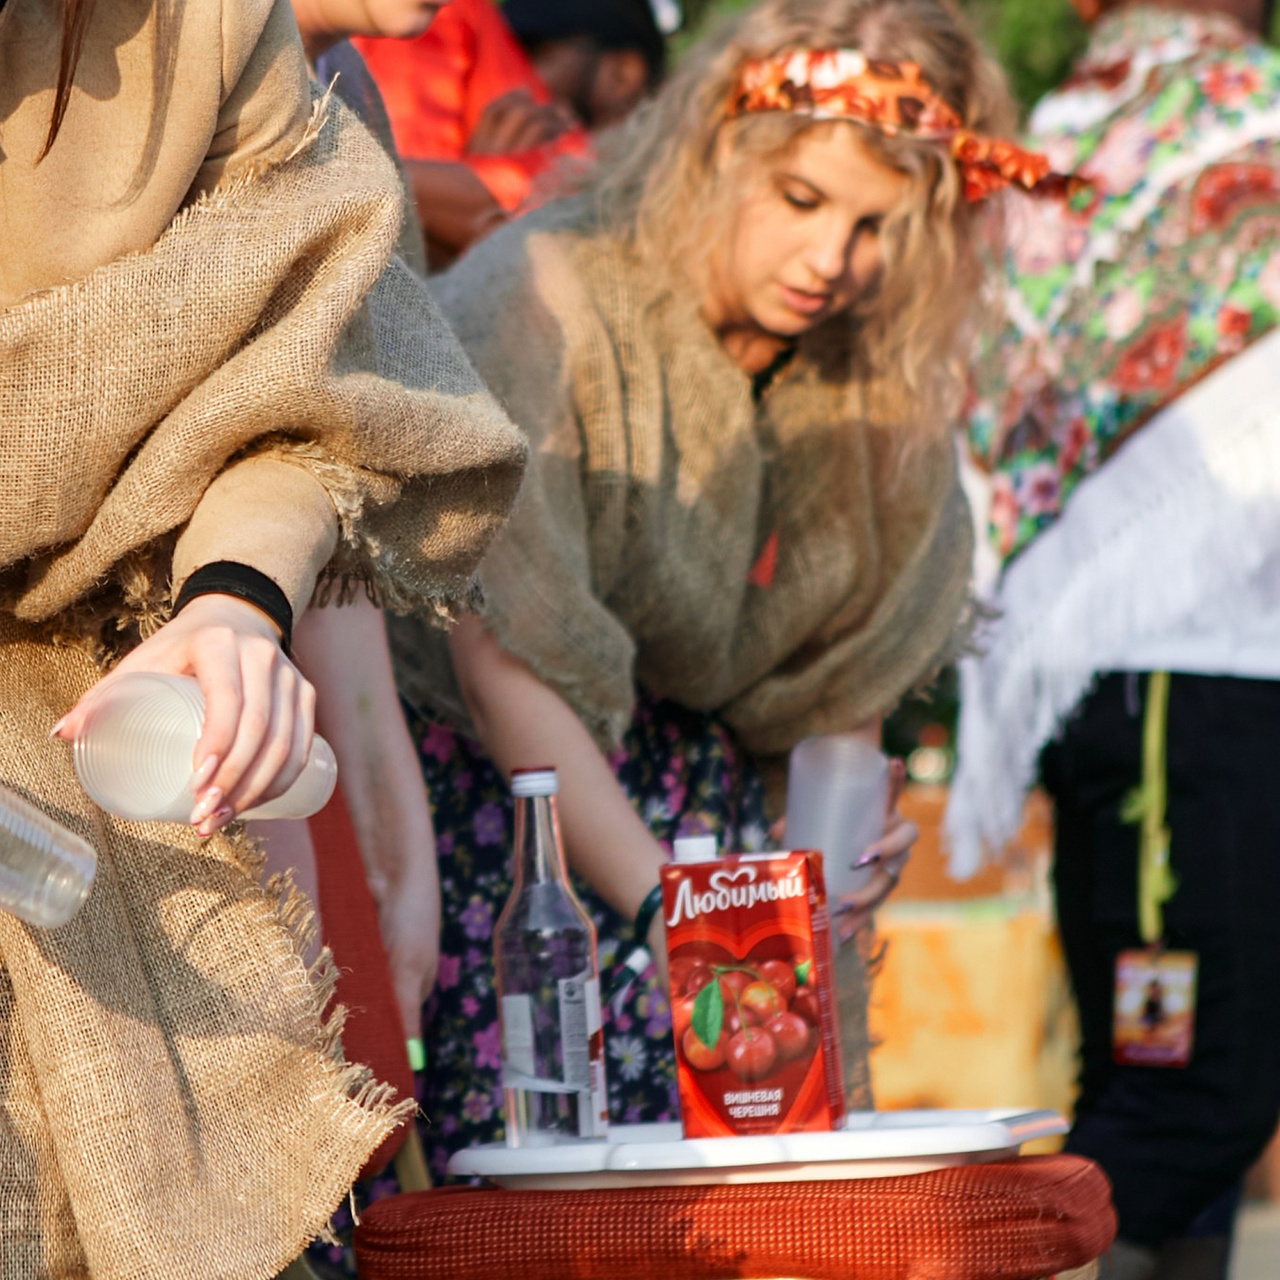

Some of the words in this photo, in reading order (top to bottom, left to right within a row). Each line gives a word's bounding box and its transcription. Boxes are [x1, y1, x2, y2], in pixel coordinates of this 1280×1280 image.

[667, 866, 806, 927] Любимый
[724, 1089, 783, 1106] ВИШНЕВАЯ
[729, 1103, 780, 1119] ЧЕРЕШНЯ
